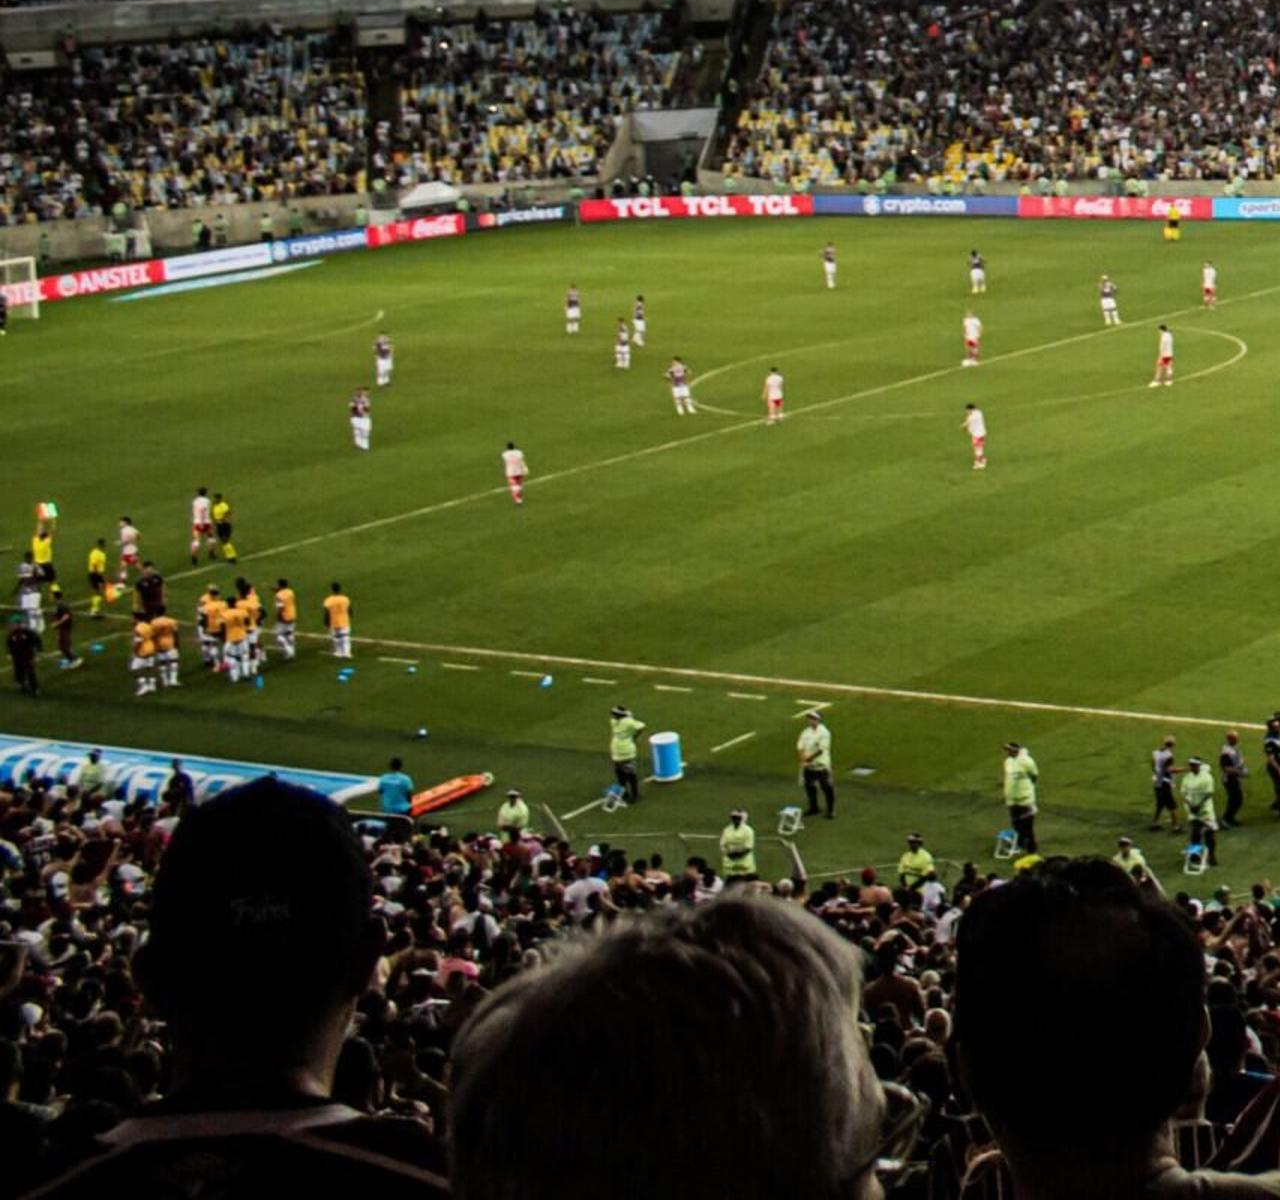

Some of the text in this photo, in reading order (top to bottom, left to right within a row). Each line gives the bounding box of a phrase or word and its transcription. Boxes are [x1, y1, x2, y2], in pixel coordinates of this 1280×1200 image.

[611, 198, 670, 218] TCL
[682, 197, 737, 216] TCL
[748, 196, 799, 215] TCL
[883, 198, 967, 214] crypto.com
[79, 262, 151, 294] AMSTEL
